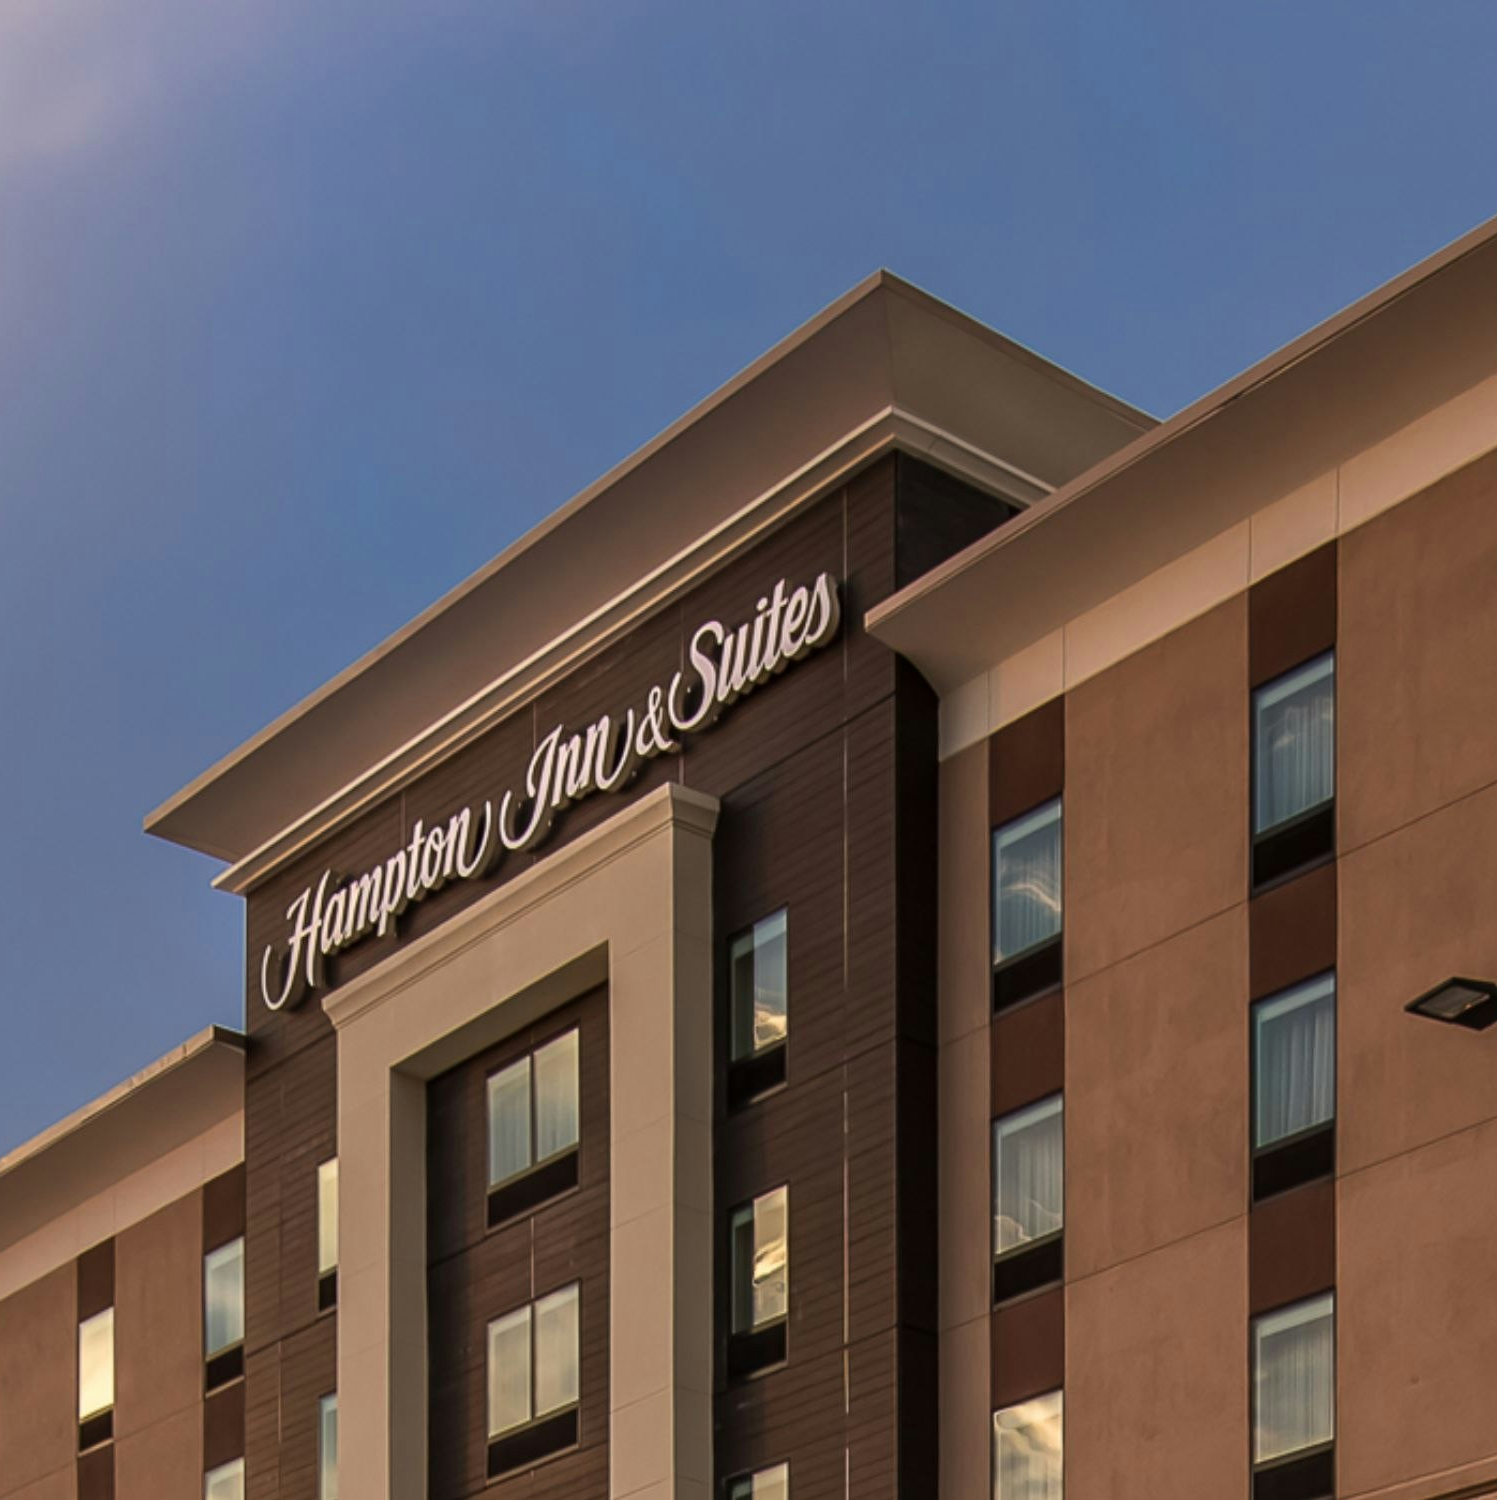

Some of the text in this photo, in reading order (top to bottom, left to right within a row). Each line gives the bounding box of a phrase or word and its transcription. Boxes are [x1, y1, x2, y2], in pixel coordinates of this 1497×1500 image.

[261, 572, 840, 1011] Hampton Inn & Suites
